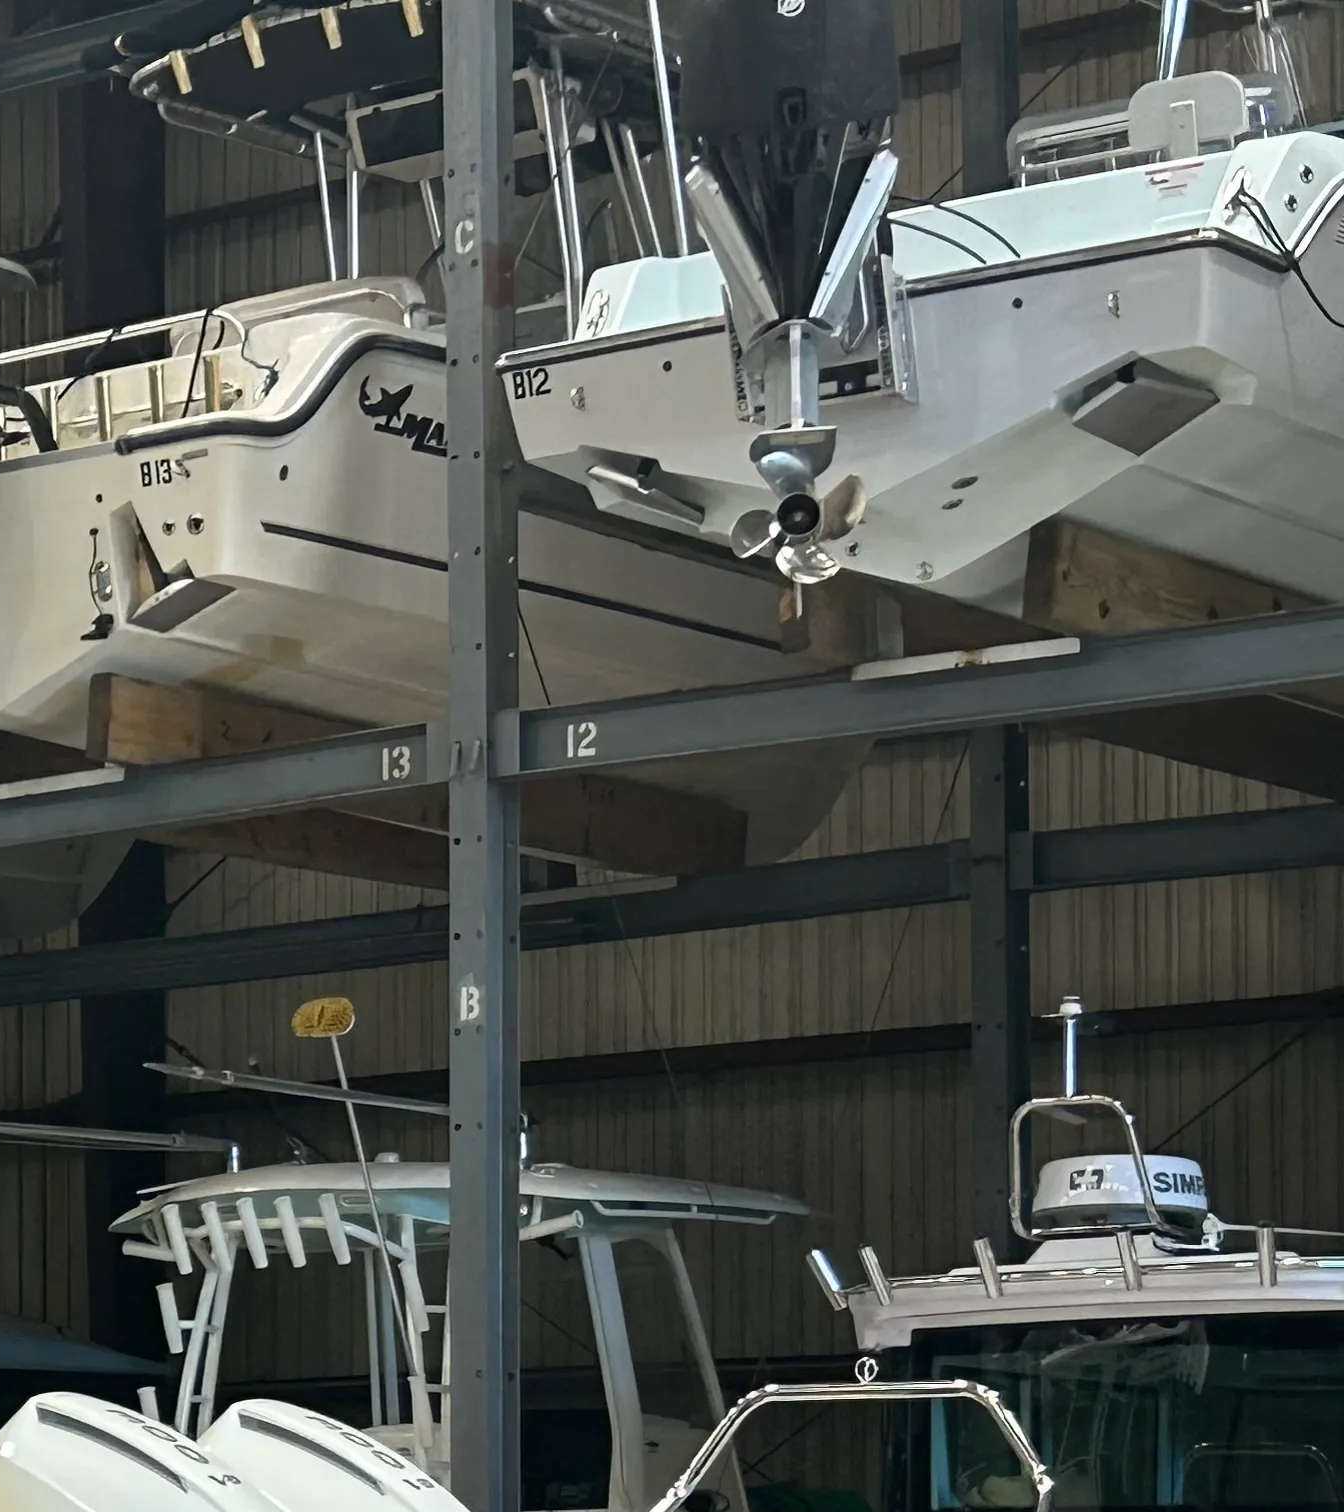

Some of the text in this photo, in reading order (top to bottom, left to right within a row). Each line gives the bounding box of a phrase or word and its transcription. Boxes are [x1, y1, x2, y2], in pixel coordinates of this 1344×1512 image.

[454, 220, 475, 254] C
[512, 367, 552, 400] B12
[140, 459, 172, 487] B13
[567, 721, 598, 758] 12
[382, 746, 411, 781] 13
[460, 985, 480, 1021] B
